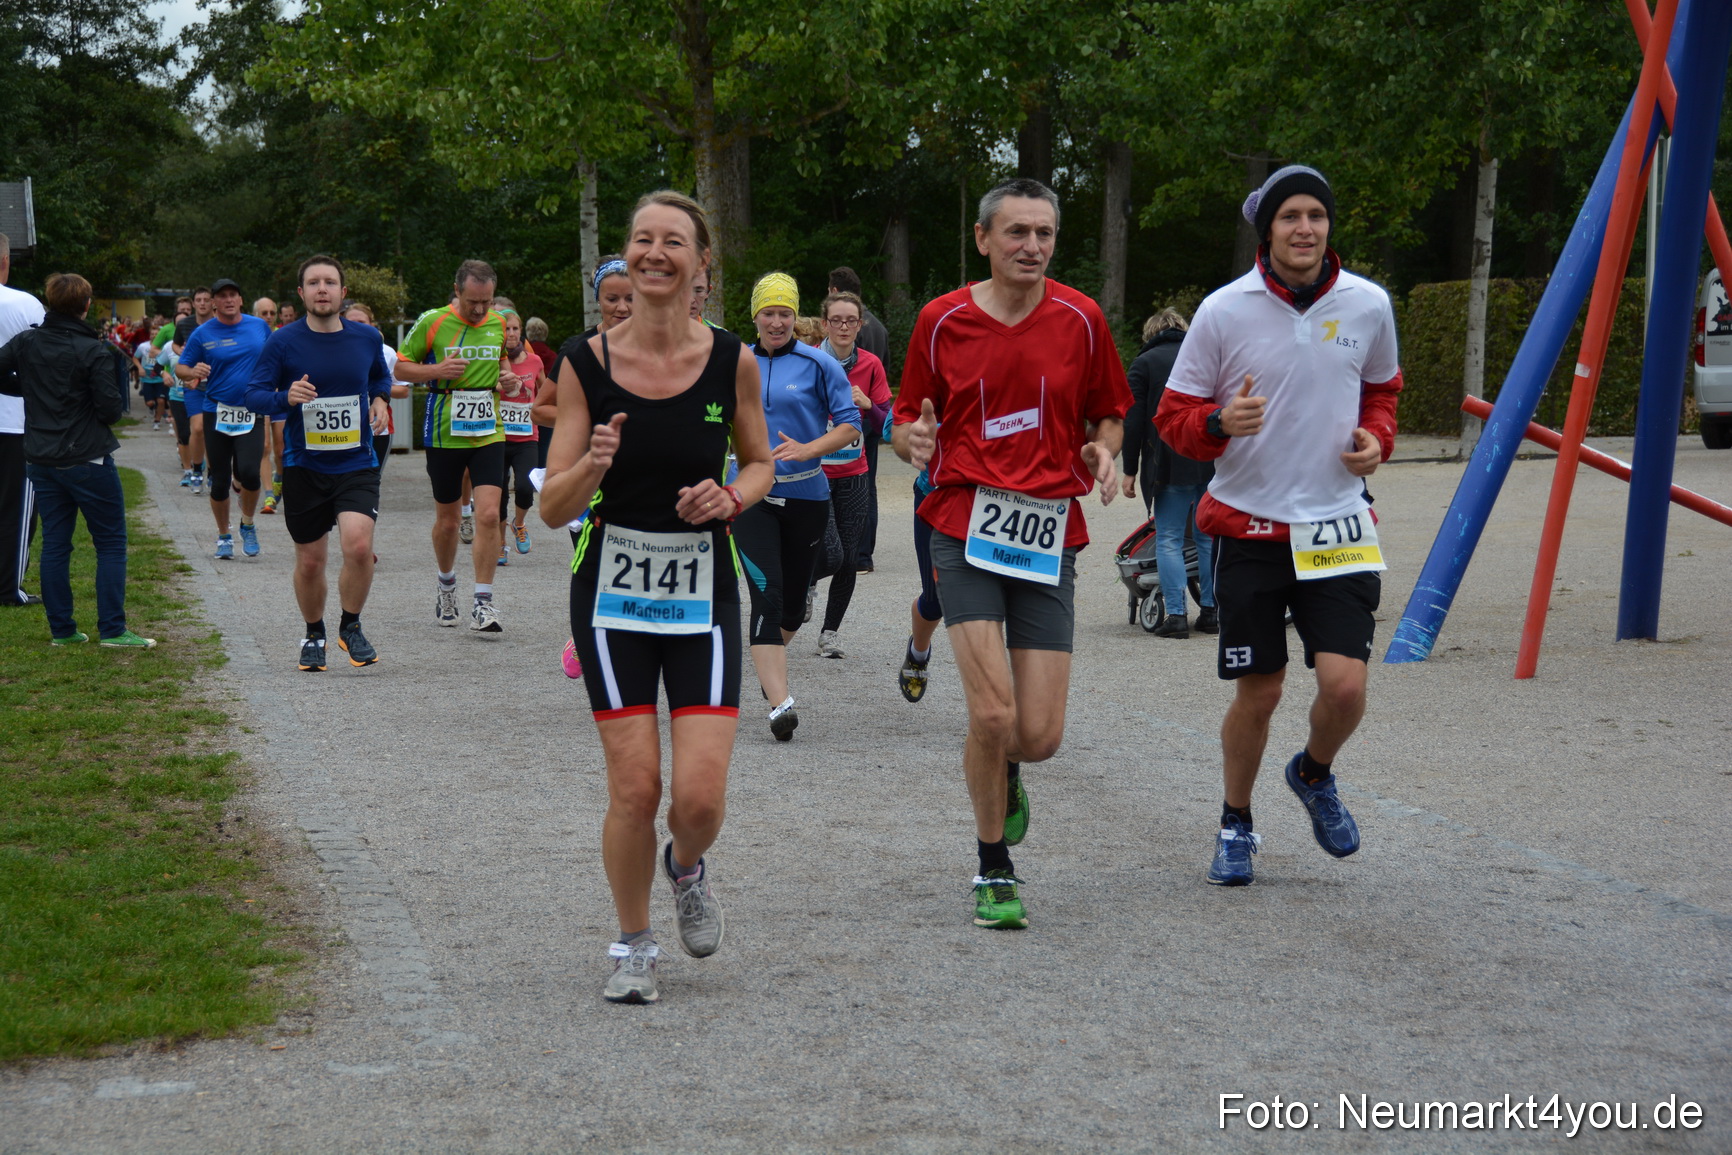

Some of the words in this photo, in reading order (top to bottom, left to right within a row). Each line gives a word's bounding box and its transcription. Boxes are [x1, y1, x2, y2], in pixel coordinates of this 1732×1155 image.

[1336, 336, 1359, 350] I.S.T.
[325, 401, 352, 409] Neumarkt
[456, 401, 492, 419] 2793
[221, 410, 252, 423] 2196
[315, 409, 351, 430] 356
[501, 409, 530, 423] 2812
[999, 417, 1023, 432] DEHN
[320, 434, 348, 443] Markus
[978, 486, 1011, 503] PARTL
[1013, 495, 1055, 512] Neumarkt
[979, 503, 1057, 550] 2408
[1246, 517, 1273, 535] 53
[1310, 514, 1362, 546] 210
[606, 534, 640, 551] PARTL
[642, 542, 695, 553] Neumarkt
[992, 547, 1032, 568] Martin
[1312, 551, 1365, 567] Christian
[611, 552, 699, 594] 2141
[622, 600, 685, 620] Manuela
[1225, 646, 1252, 668] 53
